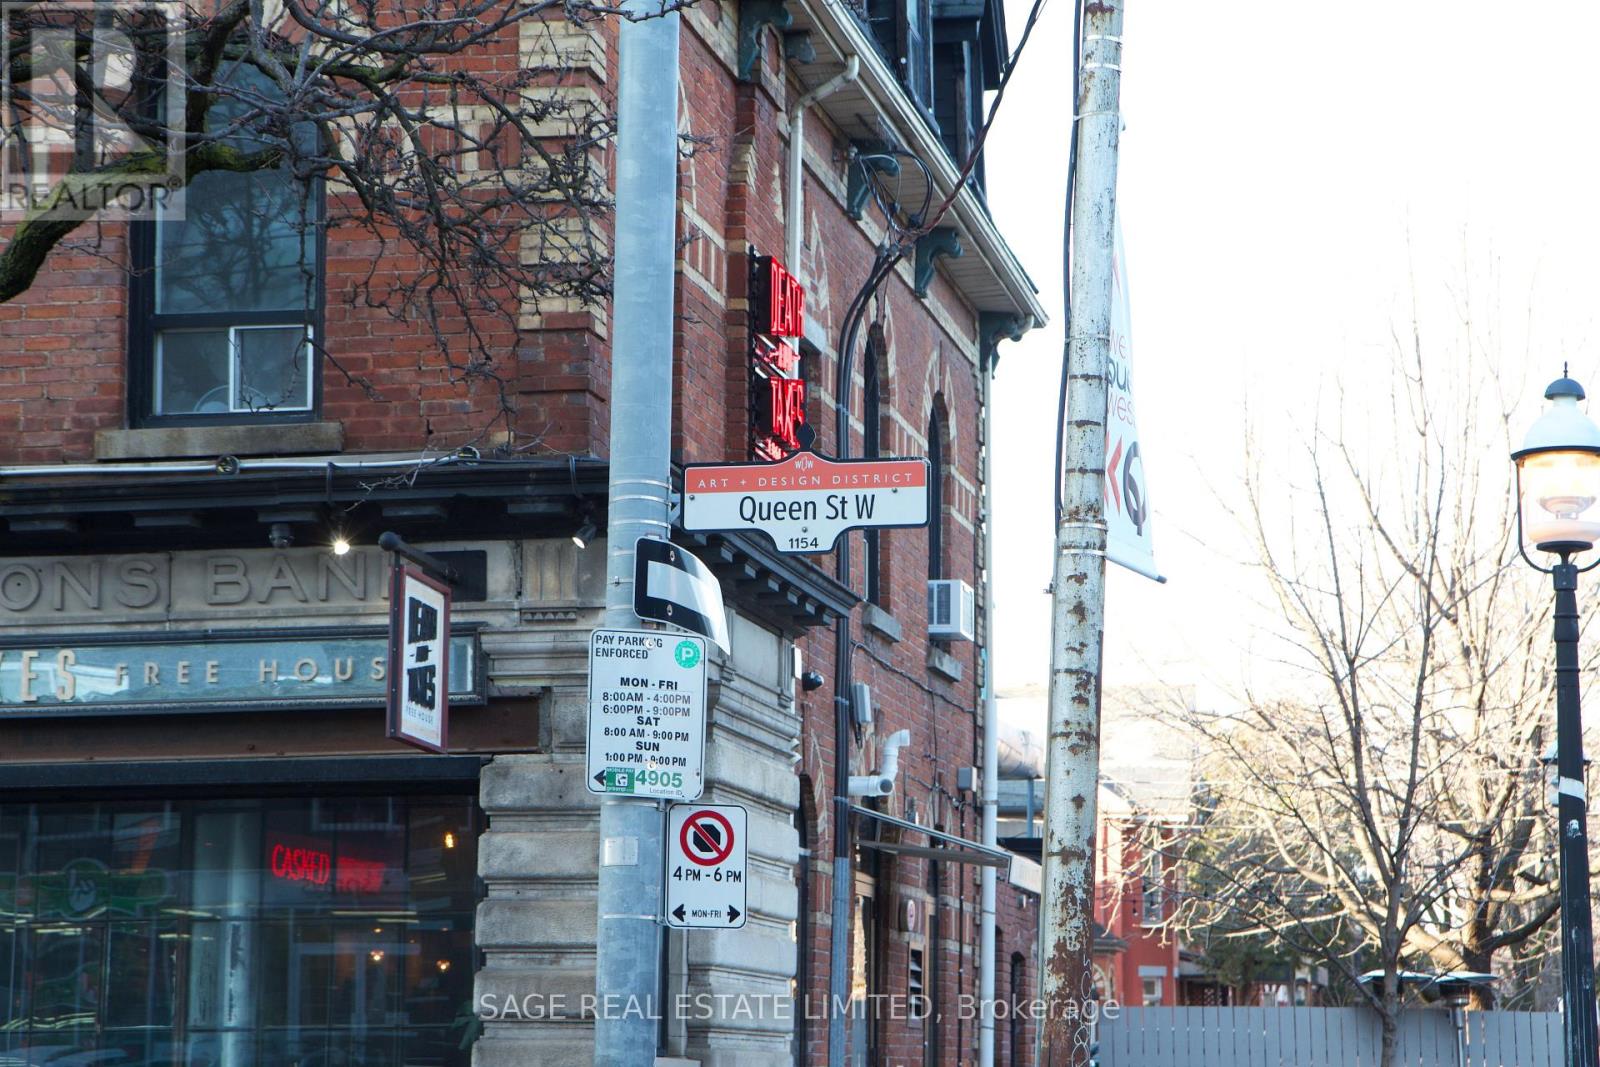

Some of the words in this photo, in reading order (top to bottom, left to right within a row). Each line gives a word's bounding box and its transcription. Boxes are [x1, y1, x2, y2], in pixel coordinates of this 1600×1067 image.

[771, 258, 805, 337] DEATH
[698, 478, 729, 489] ART
[758, 475, 821, 487] DESIGN
[832, 473, 913, 485] DISTRICT
[739, 495, 817, 524] Queen
[826, 494, 848, 520] St
[855, 494, 876, 520] W
[788, 537, 819, 549] 1154
[595, 634, 615, 645] PAY
[618, 636, 663, 648] PARKG
[595, 647, 649, 659] ENFORCED
[681, 646, 694, 661] P
[115, 660, 220, 686] FREE
[620, 677, 648, 688] MON
[658, 680, 678, 690] FRI
[602, 692, 644, 702] 8:00AM
[653, 694, 691, 705] 4:00PM
[603, 705, 643, 715] 6:00PM
[653, 707, 691, 717] 9:00PM
[637, 716, 660, 726] SAT
[604, 727, 626, 737] 8:00
[629, 729, 645, 738] AM
[652, 731, 673, 741] 9:00
[675, 732, 689, 742] PM
[636, 741, 660, 752] SUN
[605, 752, 626, 762] 1:00
[627, 753, 643, 764] PM
[672, 756, 687, 767] PM
[635, 769, 683, 789] 4905
[673, 866, 682, 881] 4
[686, 869, 701, 881] PM
[713, 867, 722, 882] 6
[726, 871, 741, 882] PM
[692, 910, 722, 918] MON-FRI
